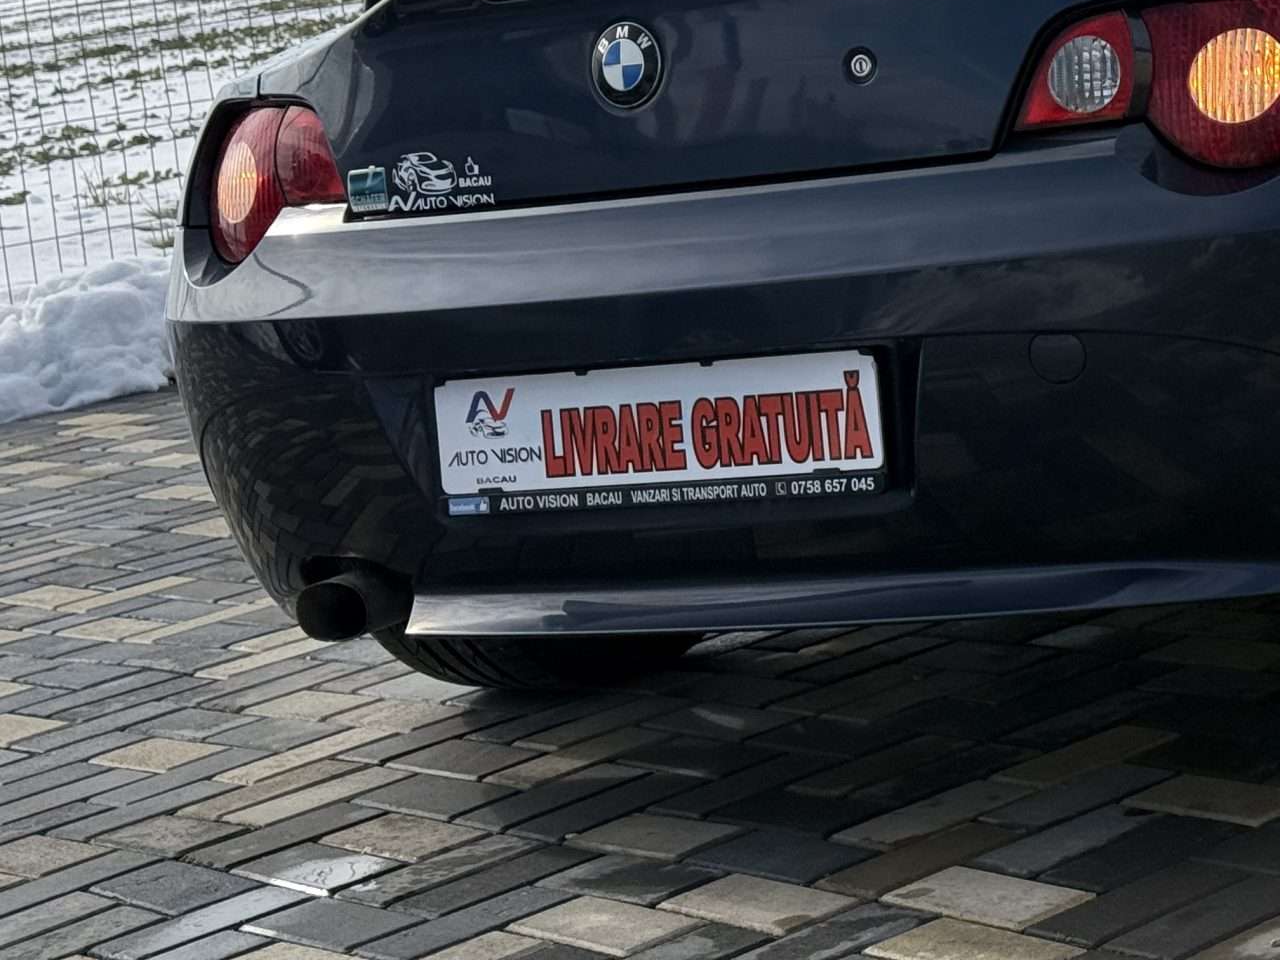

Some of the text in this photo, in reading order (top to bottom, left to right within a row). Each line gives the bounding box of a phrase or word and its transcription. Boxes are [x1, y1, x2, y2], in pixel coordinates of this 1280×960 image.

[597, 25, 652, 54] BMW
[458, 176, 492, 188] BACAU
[412, 192, 496, 211] AUTO VISION
[540, 370, 874, 478] LIVRARE GRATUITĂ
[448, 445, 542, 467] AUTO VISION
[476, 475, 517, 485] BACAU
[500, 476, 874, 511] AUTO VISION BACAU VANZARI SI TRANSPORT AUTO 0758 657 045
